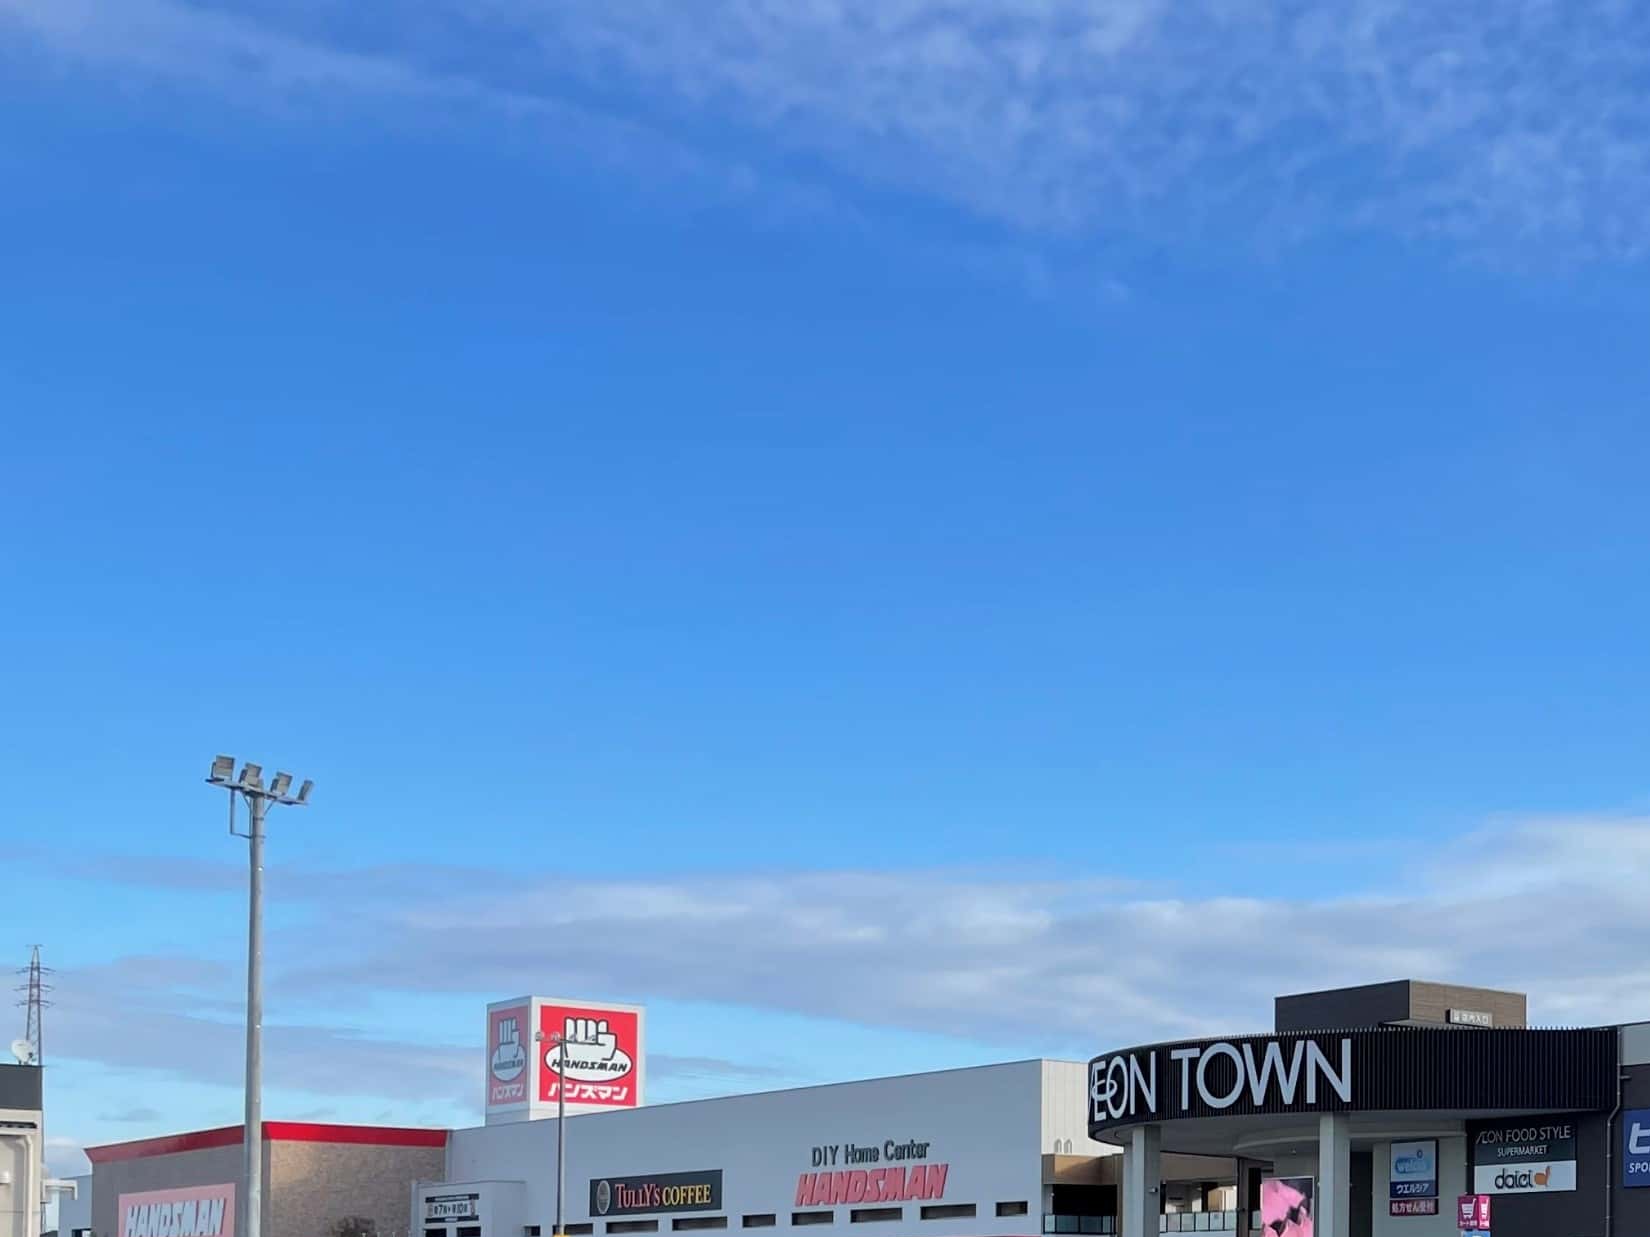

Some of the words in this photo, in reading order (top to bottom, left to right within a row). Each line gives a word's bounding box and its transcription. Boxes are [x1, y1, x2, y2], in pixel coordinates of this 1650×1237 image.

[551, 1058, 628, 1073] HANDSMAN
[1171, 1038, 1351, 1109] TOWN
[1505, 1127, 1537, 1142] FOOD
[1540, 1125, 1571, 1140] STYLE
[812, 1145, 839, 1167] DIY
[845, 1143, 880, 1164] Home
[884, 1138, 930, 1161] Center
[1498, 1145, 1548, 1157] SUPERMARKET
[795, 1164, 949, 1207] HANDSMAN
[1495, 1168, 1533, 1189] daiei
[662, 1184, 712, 1206] COFFEE
